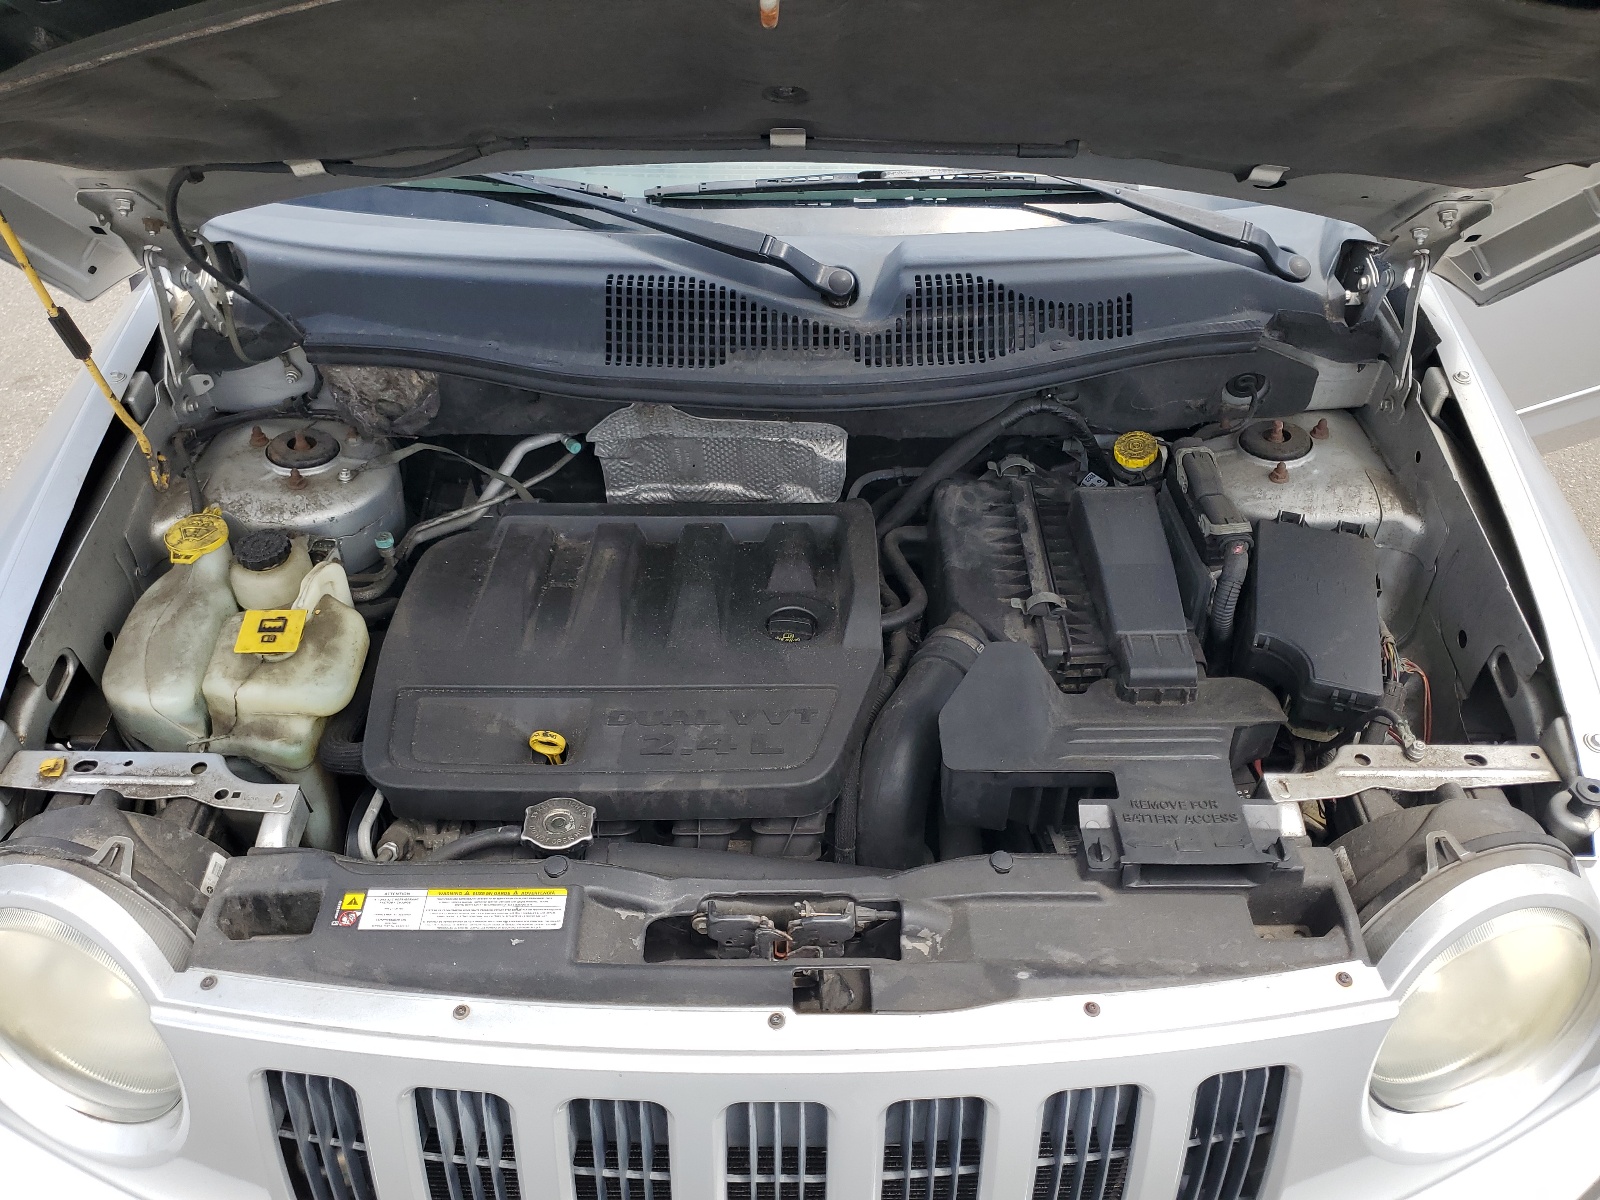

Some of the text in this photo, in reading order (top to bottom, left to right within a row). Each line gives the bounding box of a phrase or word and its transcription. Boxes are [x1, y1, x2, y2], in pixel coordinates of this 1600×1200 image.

[606, 708, 819, 727] DUAL VVT
[1130, 799, 1219, 810] REMOVE FOR
[1122, 813, 1239, 824] BATTERY ACCESS
